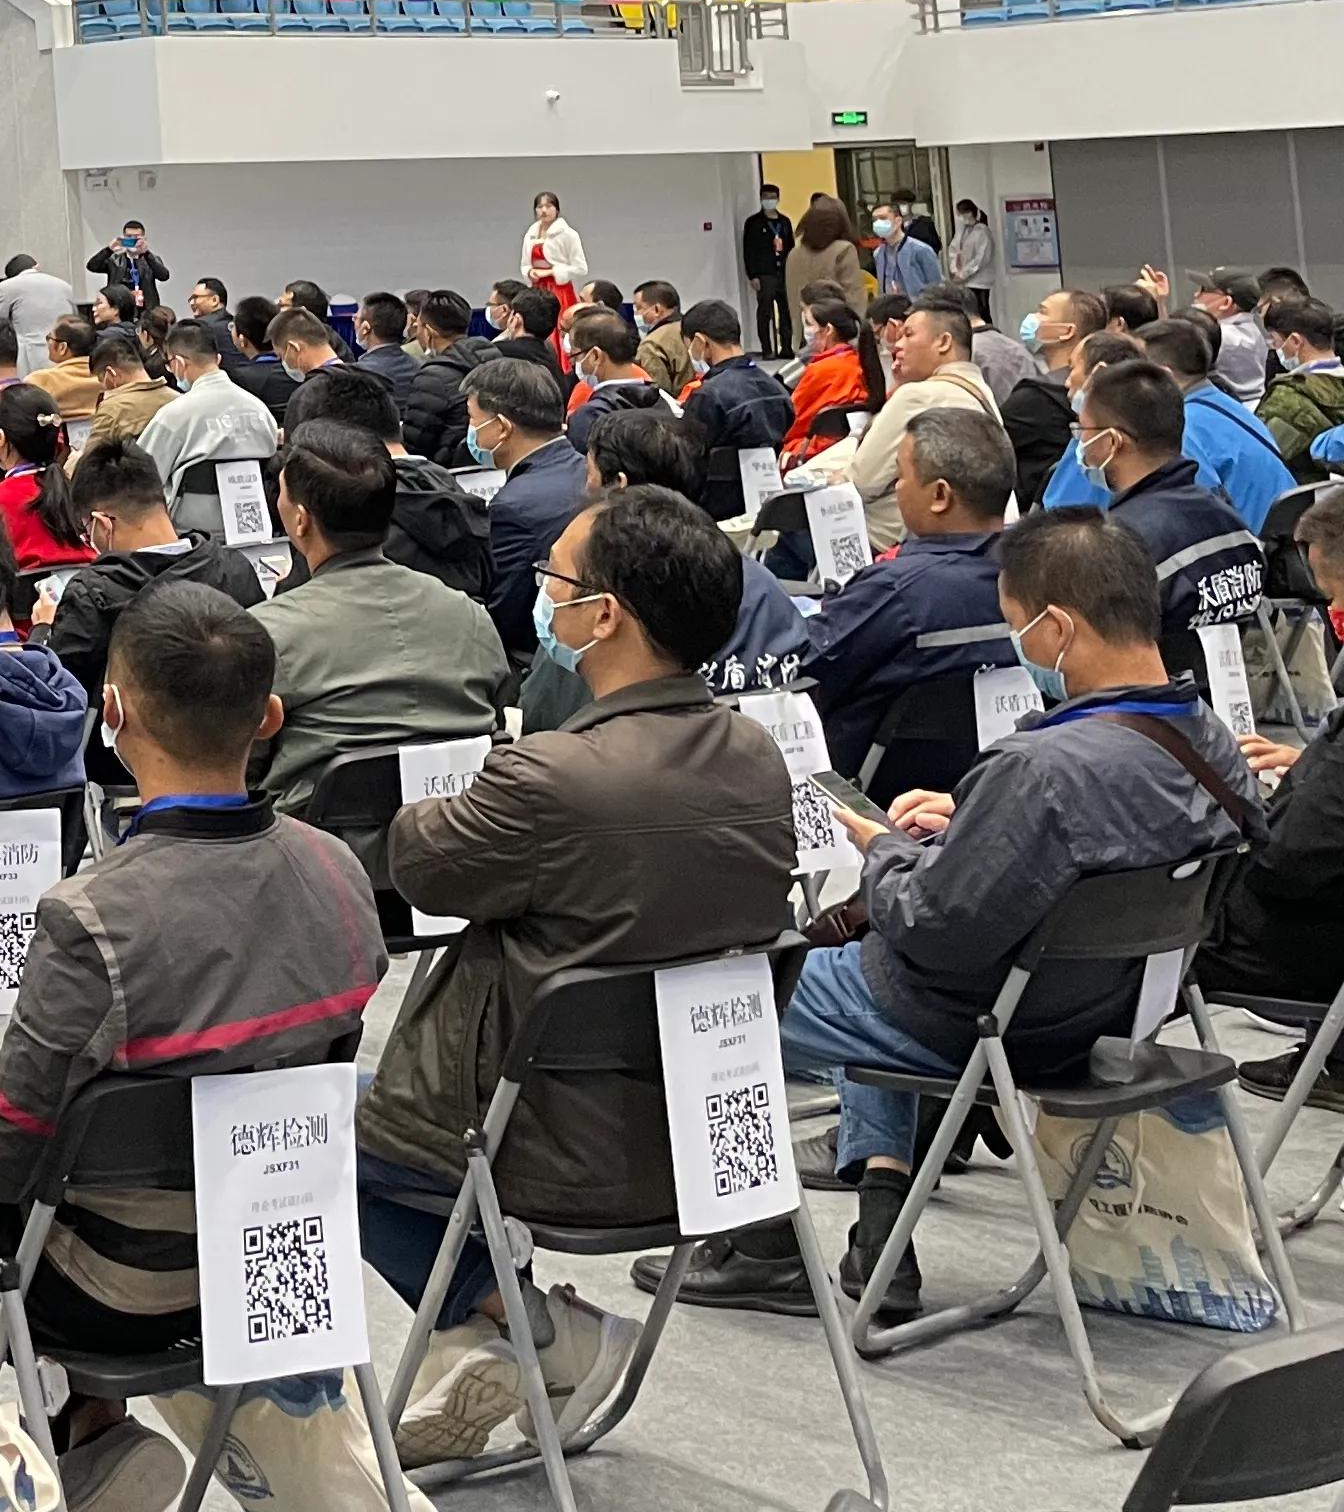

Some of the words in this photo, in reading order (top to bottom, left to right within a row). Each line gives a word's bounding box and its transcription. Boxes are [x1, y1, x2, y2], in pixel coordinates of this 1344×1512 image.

[1197, 559, 1263, 611] 沃盾消防
[689, 989, 763, 1034] 德辉检测
[230, 1112, 328, 1156] 德辉检测
[263, 1159, 300, 1175] JSXF31
